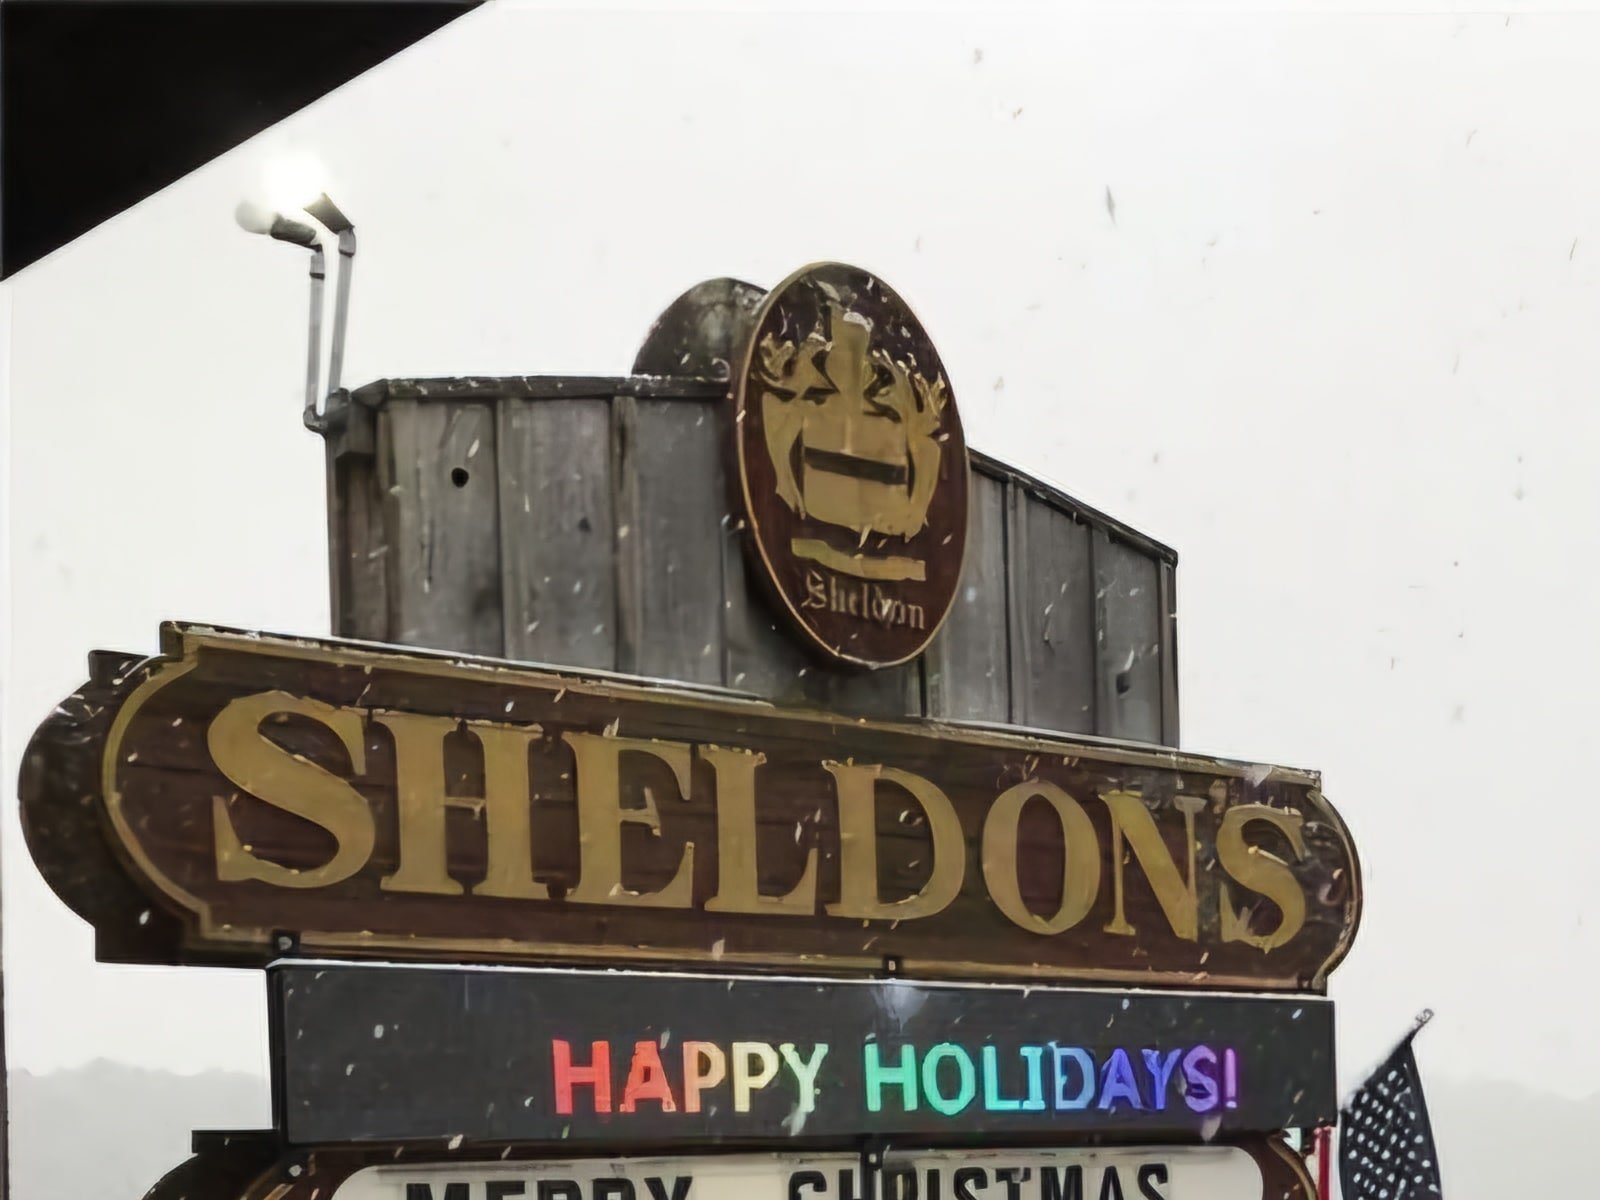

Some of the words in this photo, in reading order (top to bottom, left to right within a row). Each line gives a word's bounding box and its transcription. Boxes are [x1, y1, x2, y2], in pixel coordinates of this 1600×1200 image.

[801, 569, 925, 630] Sheldon
[206, 689, 1308, 950] SHELDONS
[553, 1040, 829, 1114] HAPPY
[865, 1042, 1238, 1115] HOLIDAYS!
